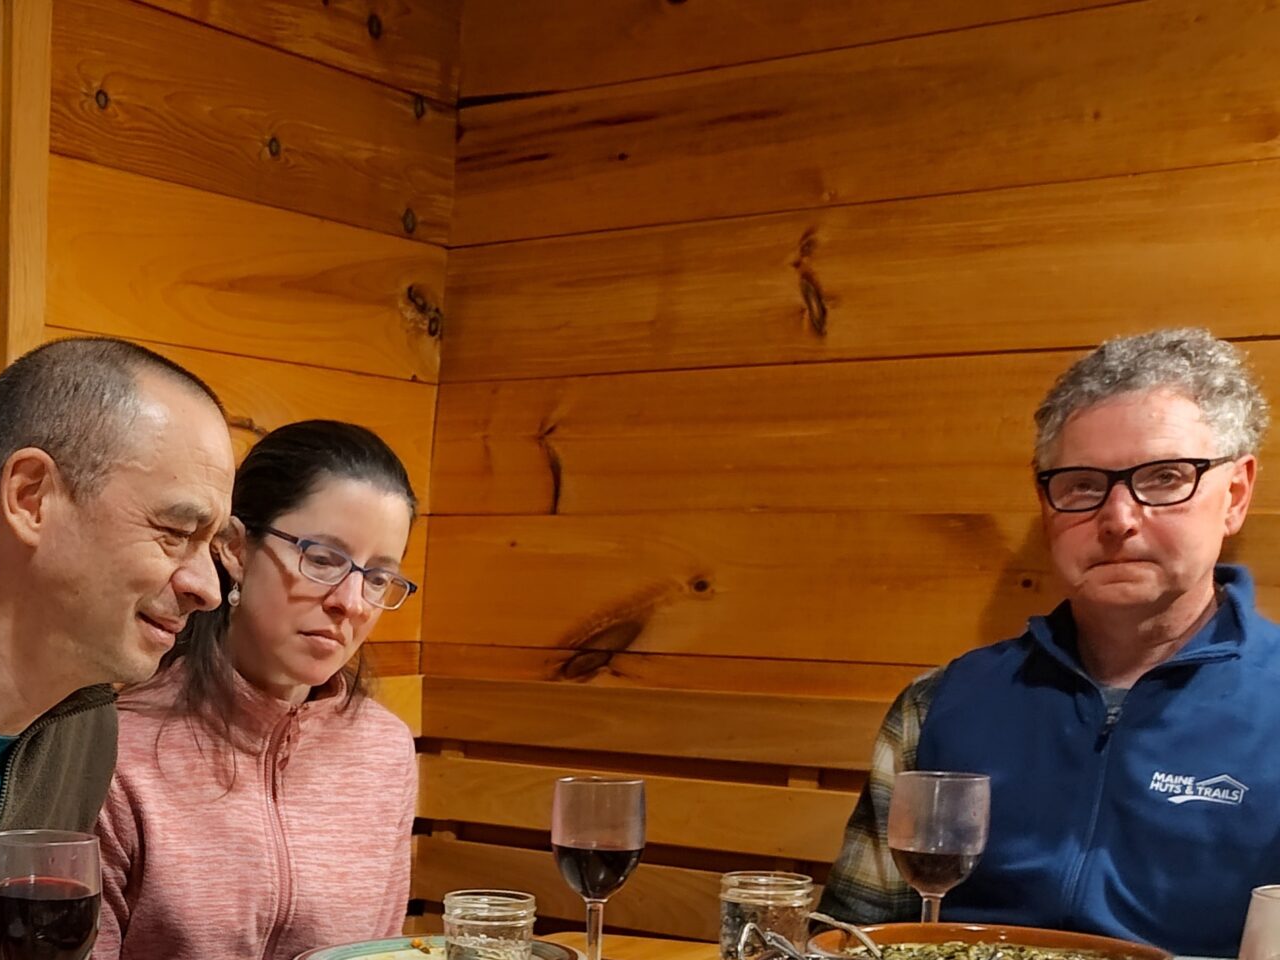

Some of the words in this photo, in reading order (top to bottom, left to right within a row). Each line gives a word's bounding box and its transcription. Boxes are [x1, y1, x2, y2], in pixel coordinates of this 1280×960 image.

[1152, 772, 1195, 785] MAINE
[1149, 780, 1182, 794] HUTS
[1185, 784, 1194, 795] &
[1196, 786, 1240, 801] TRAILS
